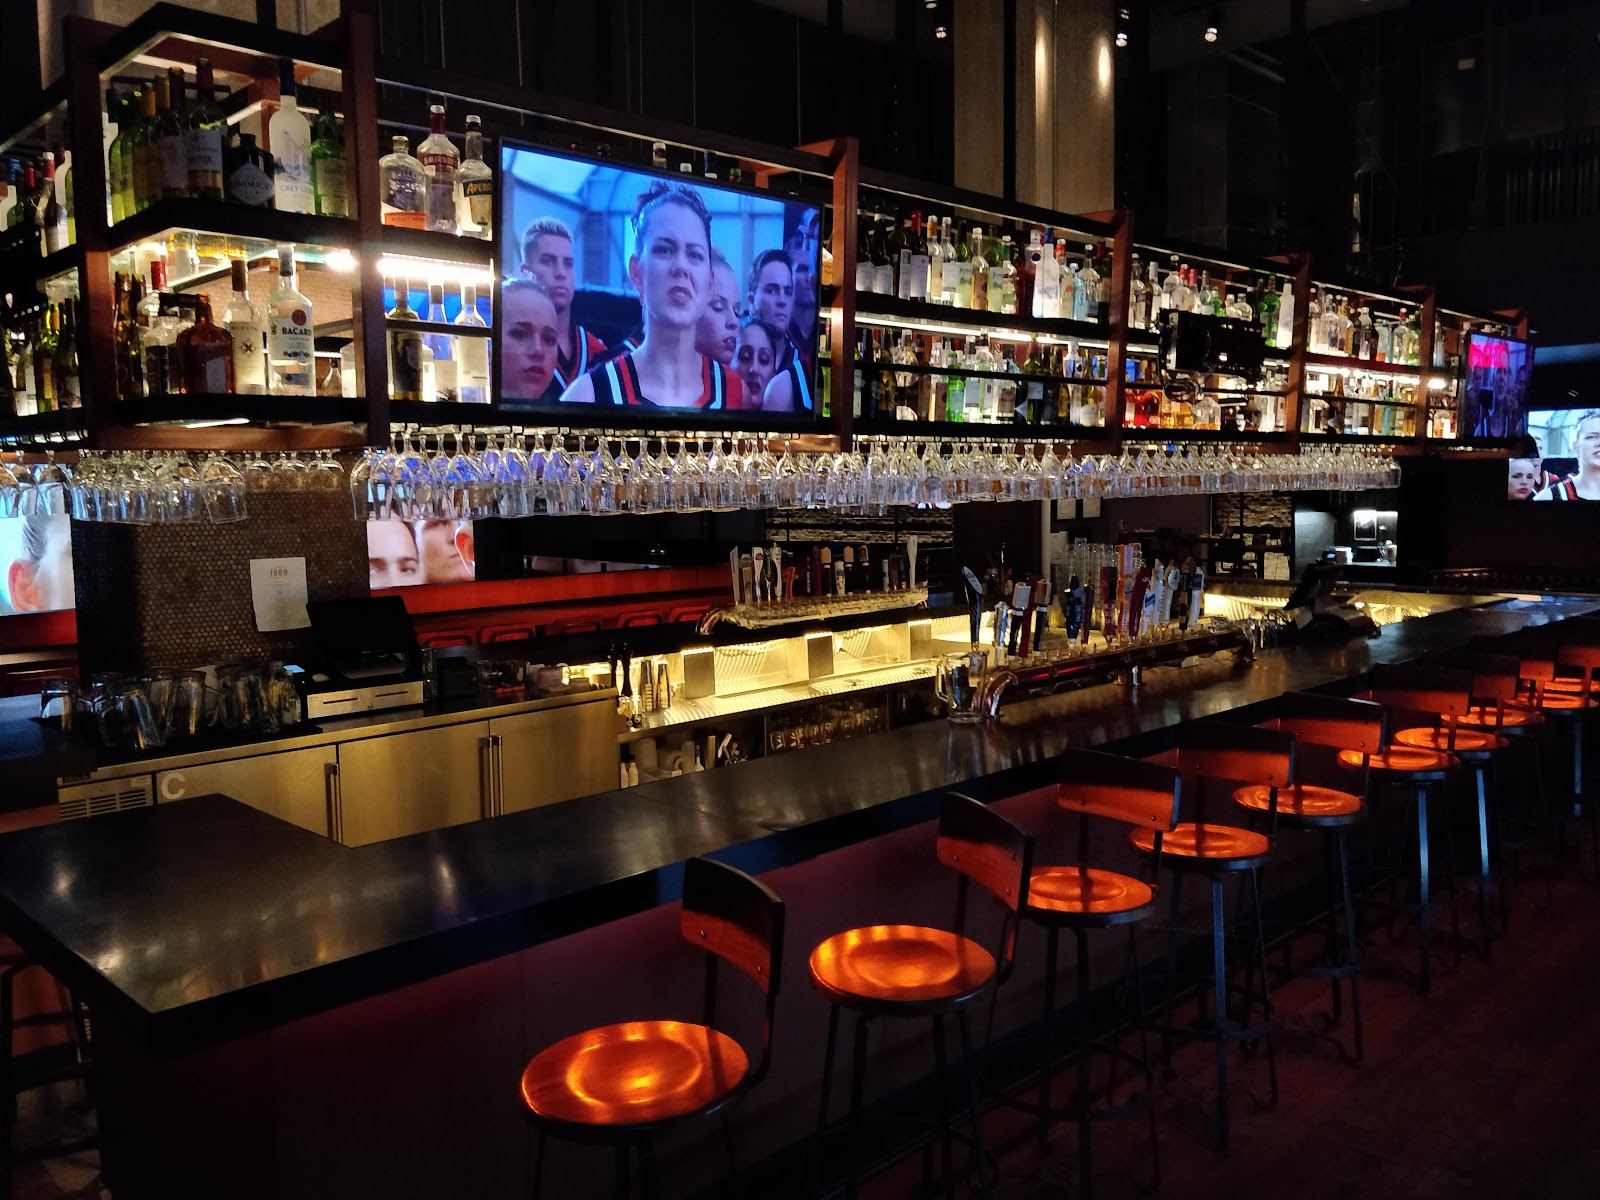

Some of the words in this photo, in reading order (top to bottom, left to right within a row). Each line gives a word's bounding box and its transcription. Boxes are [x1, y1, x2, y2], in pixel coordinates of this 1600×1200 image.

[280, 184, 299, 192] GREY
[467, 182, 492, 193] APERO
[281, 326, 312, 336] BACARD
[161, 772, 186, 800] C
